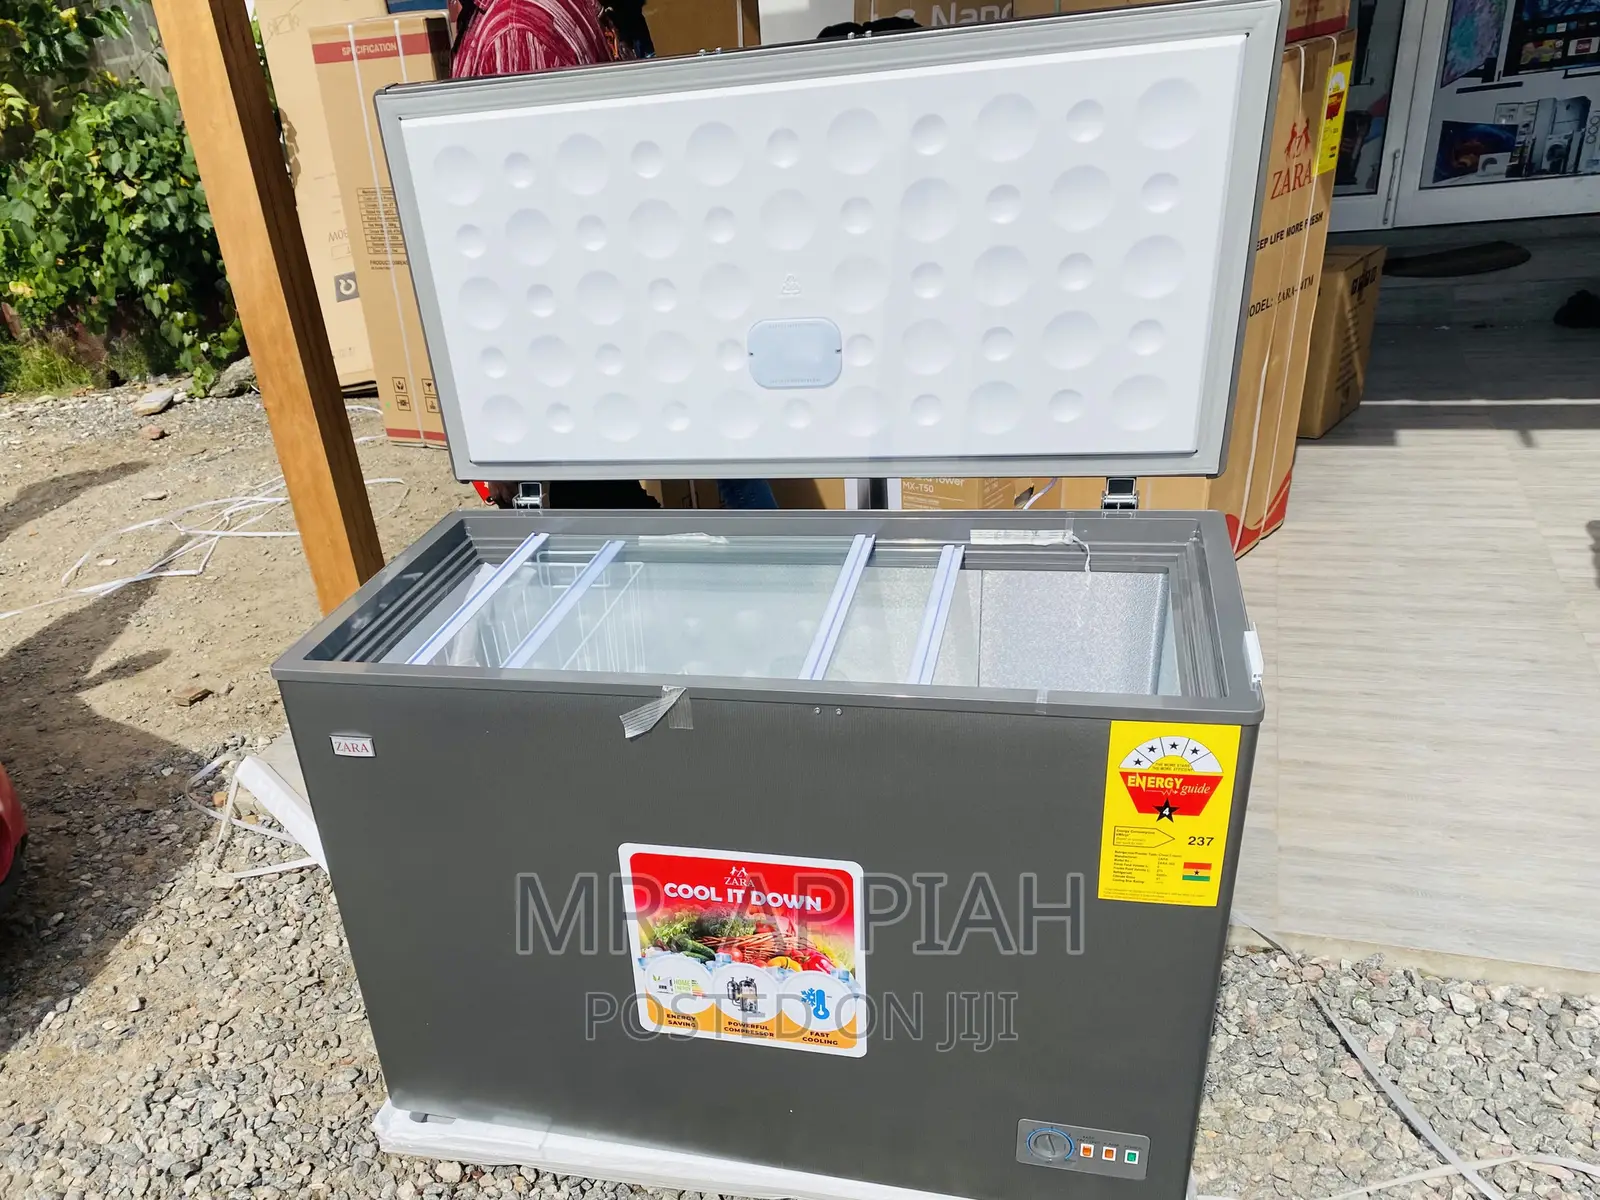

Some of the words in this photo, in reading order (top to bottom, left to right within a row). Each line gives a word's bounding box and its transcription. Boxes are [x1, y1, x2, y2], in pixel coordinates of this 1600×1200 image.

[342, 42, 397, 56] SPCIFICATION
[1271, 159, 1312, 200] ZARA
[1270, 229, 1285, 245] LIFE
[1286, 220, 1303, 237] MORE
[902, 481, 934, 493] MX-T50
[334, 741, 370, 753] ZARA
[1127, 772, 1184, 792] ENERGY
[1180, 783, 1211, 795] guide
[1162, 807, 1170, 816] 4
[1188, 836, 1215, 847] 237
[724, 876, 755, 888] ZARA
[664, 883, 722, 903] COOL
[727, 889, 745, 904] IT
[751, 891, 821, 912] DOWN
[666, 1013, 696, 1021] ENERGY
[668, 1020, 696, 1028] SAVING
[728, 1021, 769, 1031] POWERFUL
[724, 1027, 774, 1037] COMPRESSOR
[802, 1036, 838, 1046] COOLING
